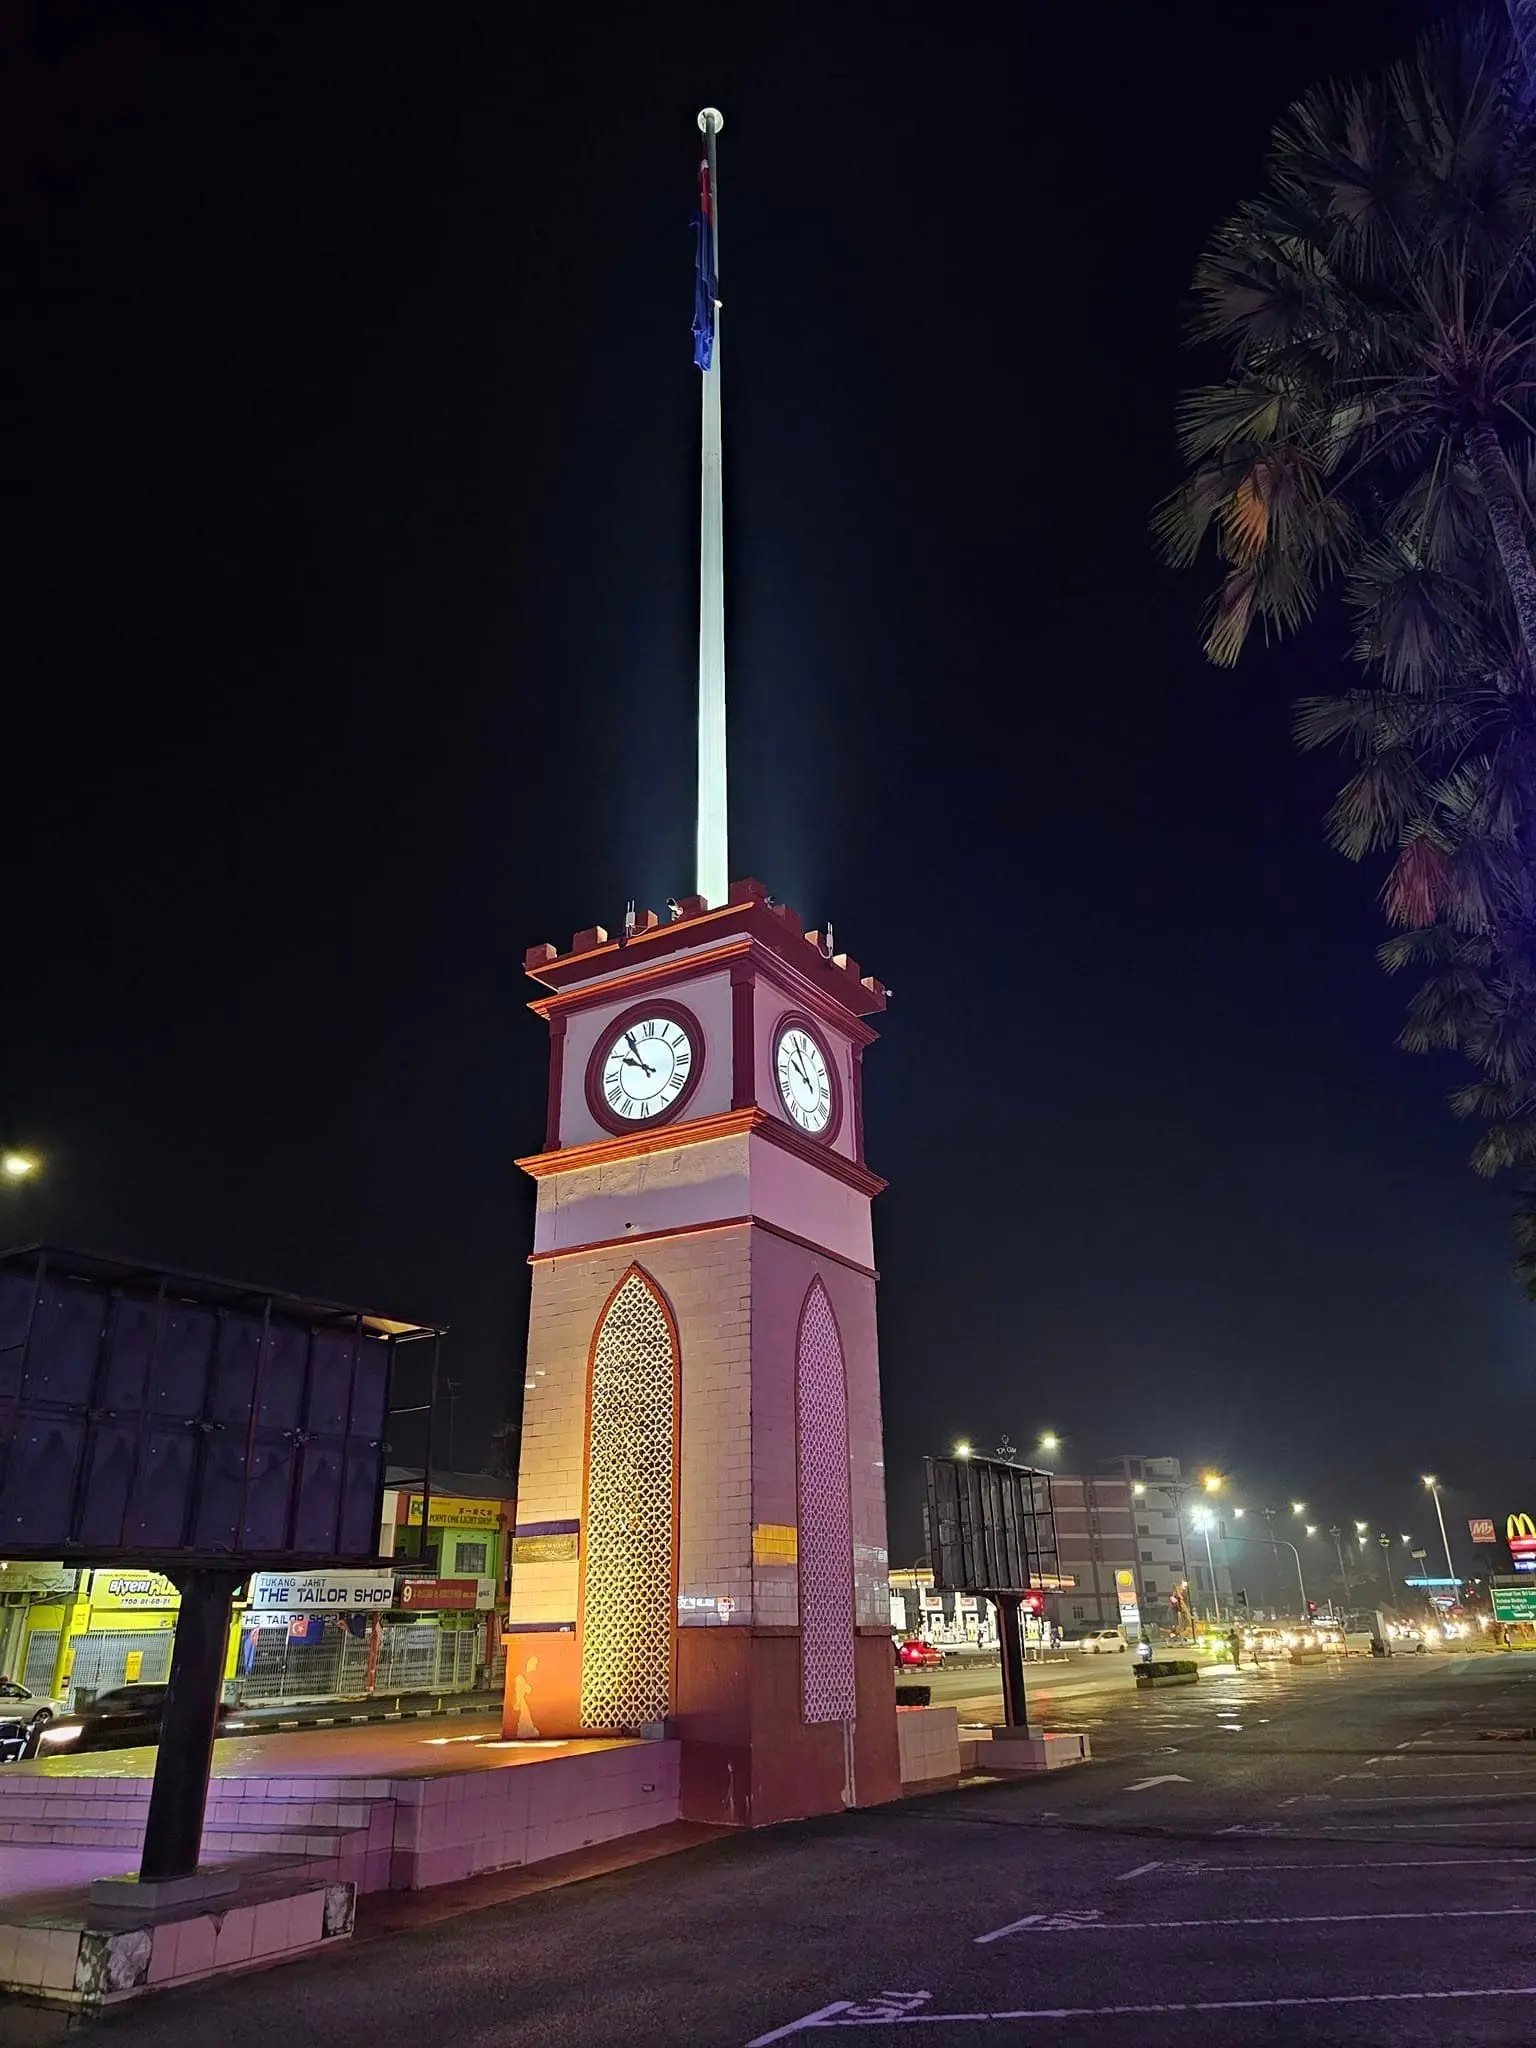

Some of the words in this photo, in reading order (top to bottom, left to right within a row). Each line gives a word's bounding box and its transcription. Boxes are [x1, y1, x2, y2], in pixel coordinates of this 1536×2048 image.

[429, 1513, 447, 1523] POINT
[260, 1578, 296, 1587] TUKANG
[302, 1578, 326, 1587] JAHIT
[259, 1588, 289, 1603] THE
[297, 1588, 348, 1603] TAILOR
[354, 1589, 391, 1603] SHOP
[403, 1585, 412, 1602] 9
[243, 1615, 260, 1625] HE
